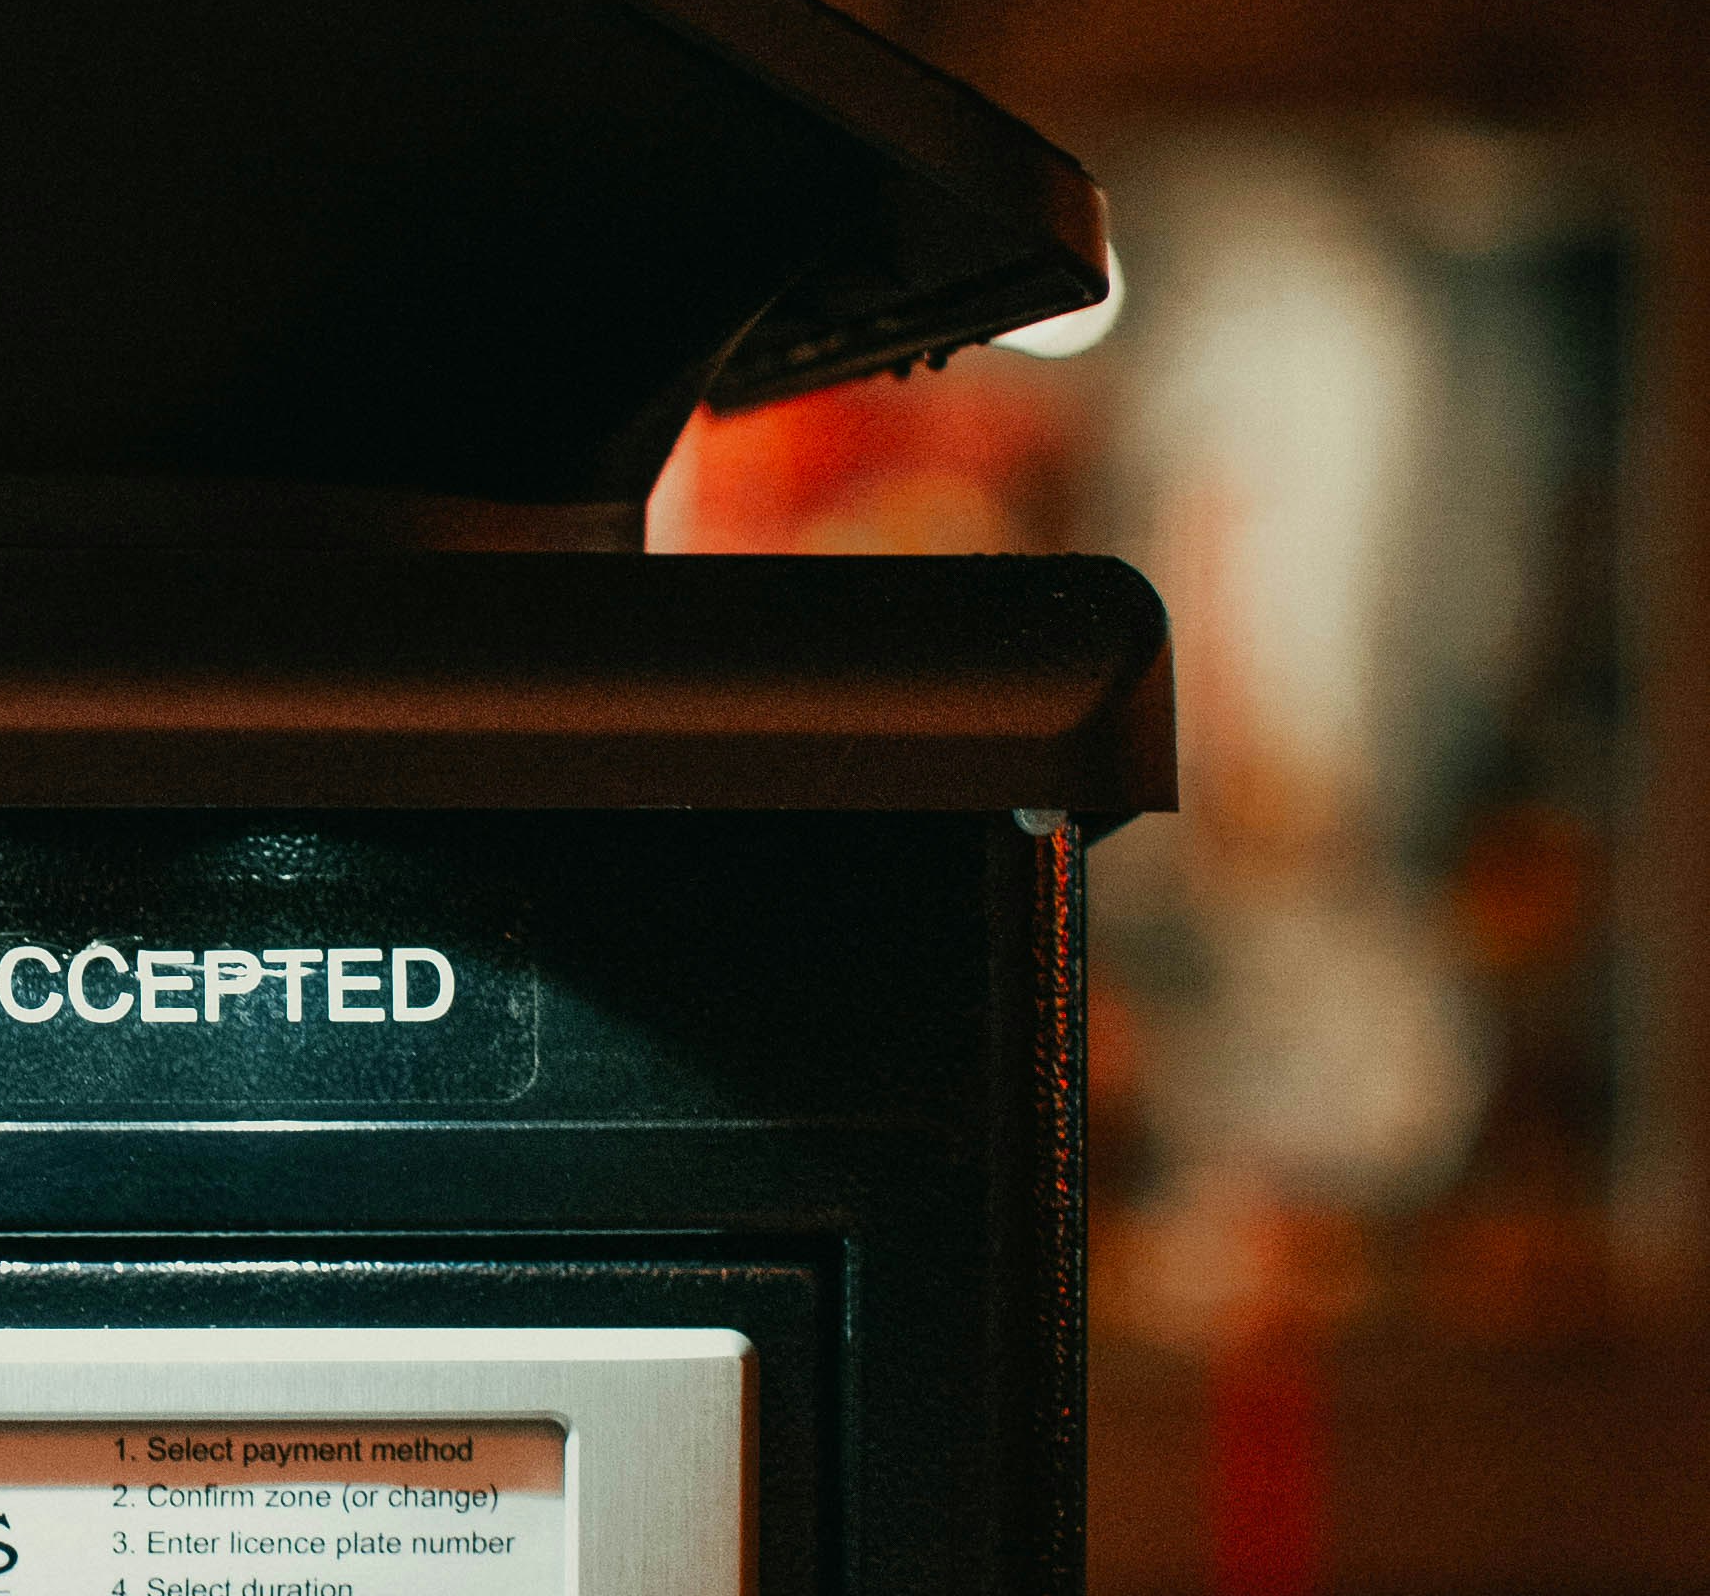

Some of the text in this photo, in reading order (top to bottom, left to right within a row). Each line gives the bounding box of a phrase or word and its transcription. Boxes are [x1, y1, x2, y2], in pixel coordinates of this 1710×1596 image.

[113, 1436, 474, 1468] 1. Select payment method
[112, 1484, 499, 1514] 2. Confirm zone (or change)
[113, 1531, 514, 1559] 3. Enter licence plate number
